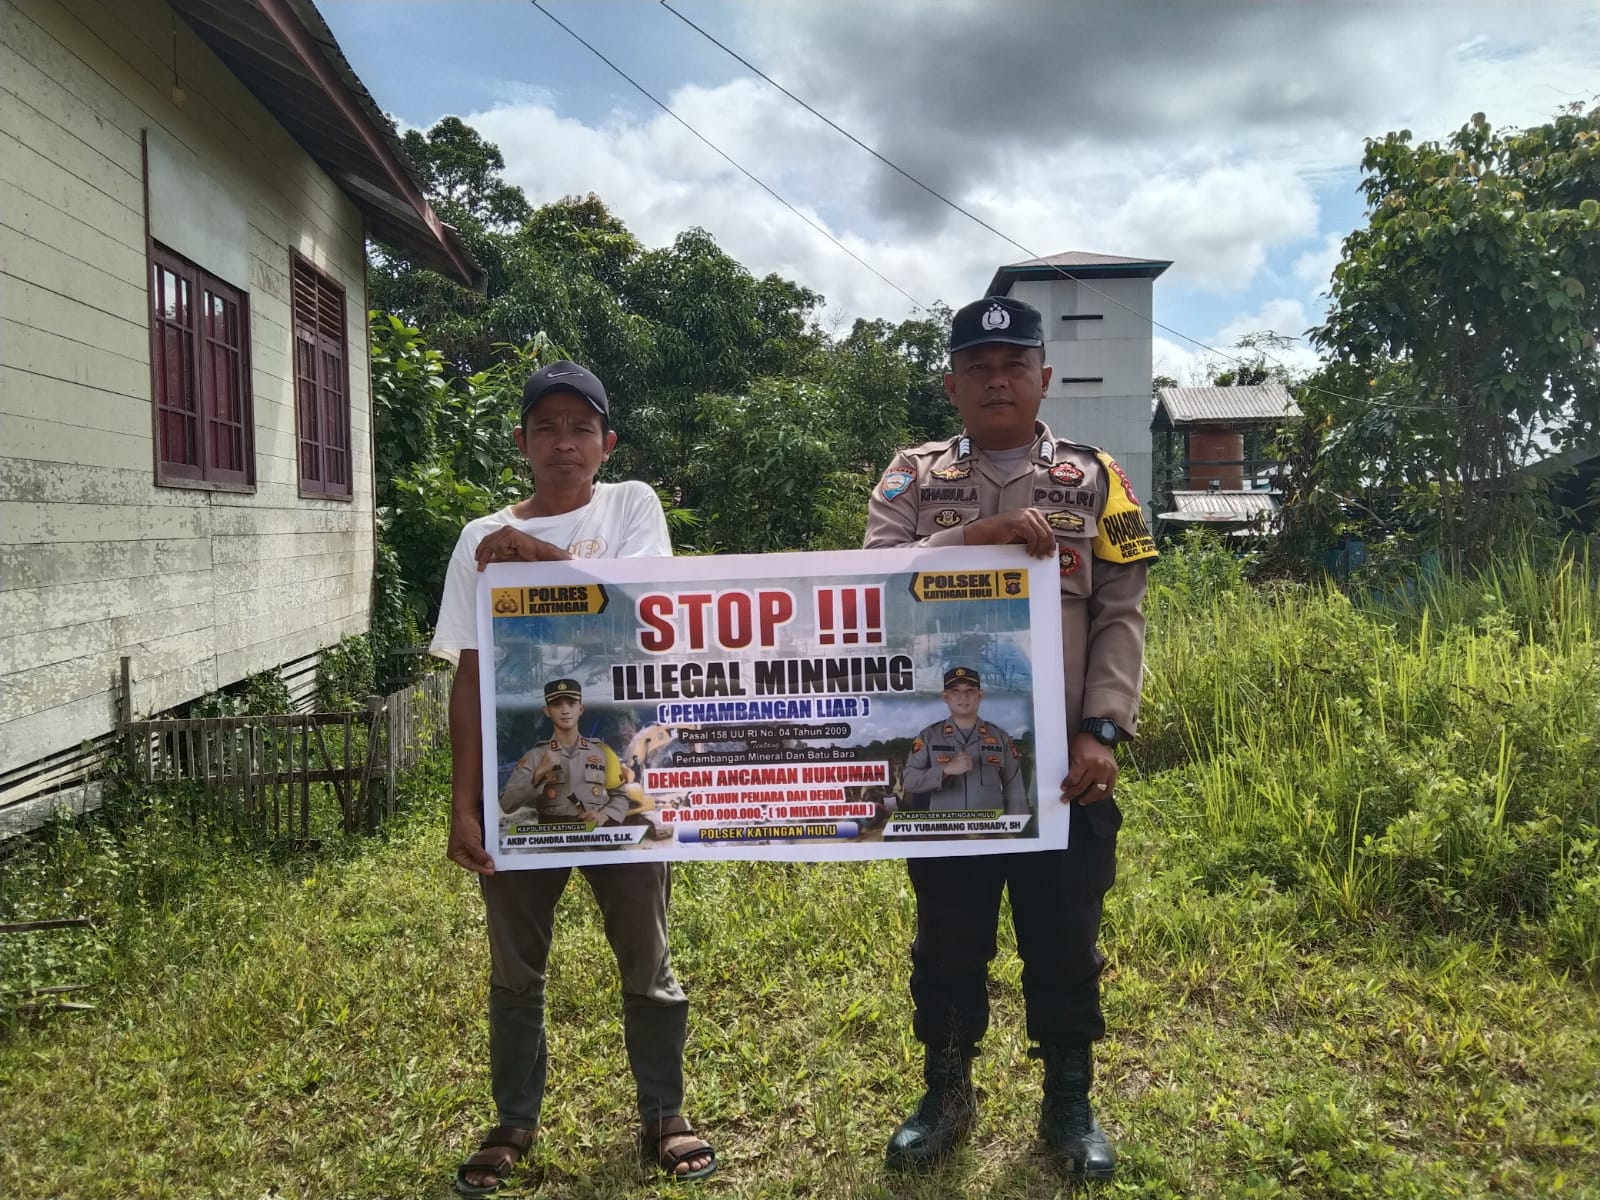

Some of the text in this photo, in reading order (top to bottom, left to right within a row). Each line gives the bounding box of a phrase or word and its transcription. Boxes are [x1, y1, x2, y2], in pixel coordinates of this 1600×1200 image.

[1034, 488, 1096, 508] POLRI
[923, 574, 992, 589] POLSEK
[528, 586, 588, 602] POLRES
[923, 588, 993, 600] KATINGAN HULU
[529, 602, 588, 614] KATINGAN
[637, 586, 883, 653] STOP !!!
[612, 655, 914, 701] ILLEGAL MINNING
[816, 698, 858, 718] LIAR
[682, 731, 708, 741] Pasal
[711, 730, 728, 740] 158
[730, 730, 745, 738] UU
[747, 729, 758, 738] RI
[779, 728, 790, 737] 04
[792, 728, 822, 737] Tahun
[824, 726, 848, 735] 2009
[676, 749, 855, 764] Pertambangan Mineral Dan Batu Bara
[647, 764, 886, 789] DENGAN ANCAMAN HUKUMAN
[690, 788, 845, 805] 10 TAHUN PENJARA DAN DENDA
[661, 810, 677, 822] RP.
[775, 806, 788, 818] 10
[789, 805, 827, 818] MILYAR
[828, 804, 867, 817] RUPIAH
[517, 823, 586, 833] KAPOLRES KATINGAN
[700, 824, 837, 840] POLSEK KATINGAN HULU
[892, 823, 912, 833] IPTU
[913, 822, 966, 832] YUBAMBANG
[1009, 820, 1021, 830] SH
[506, 837, 527, 846] AKBP
[528, 835, 564, 845] CHANDRA
